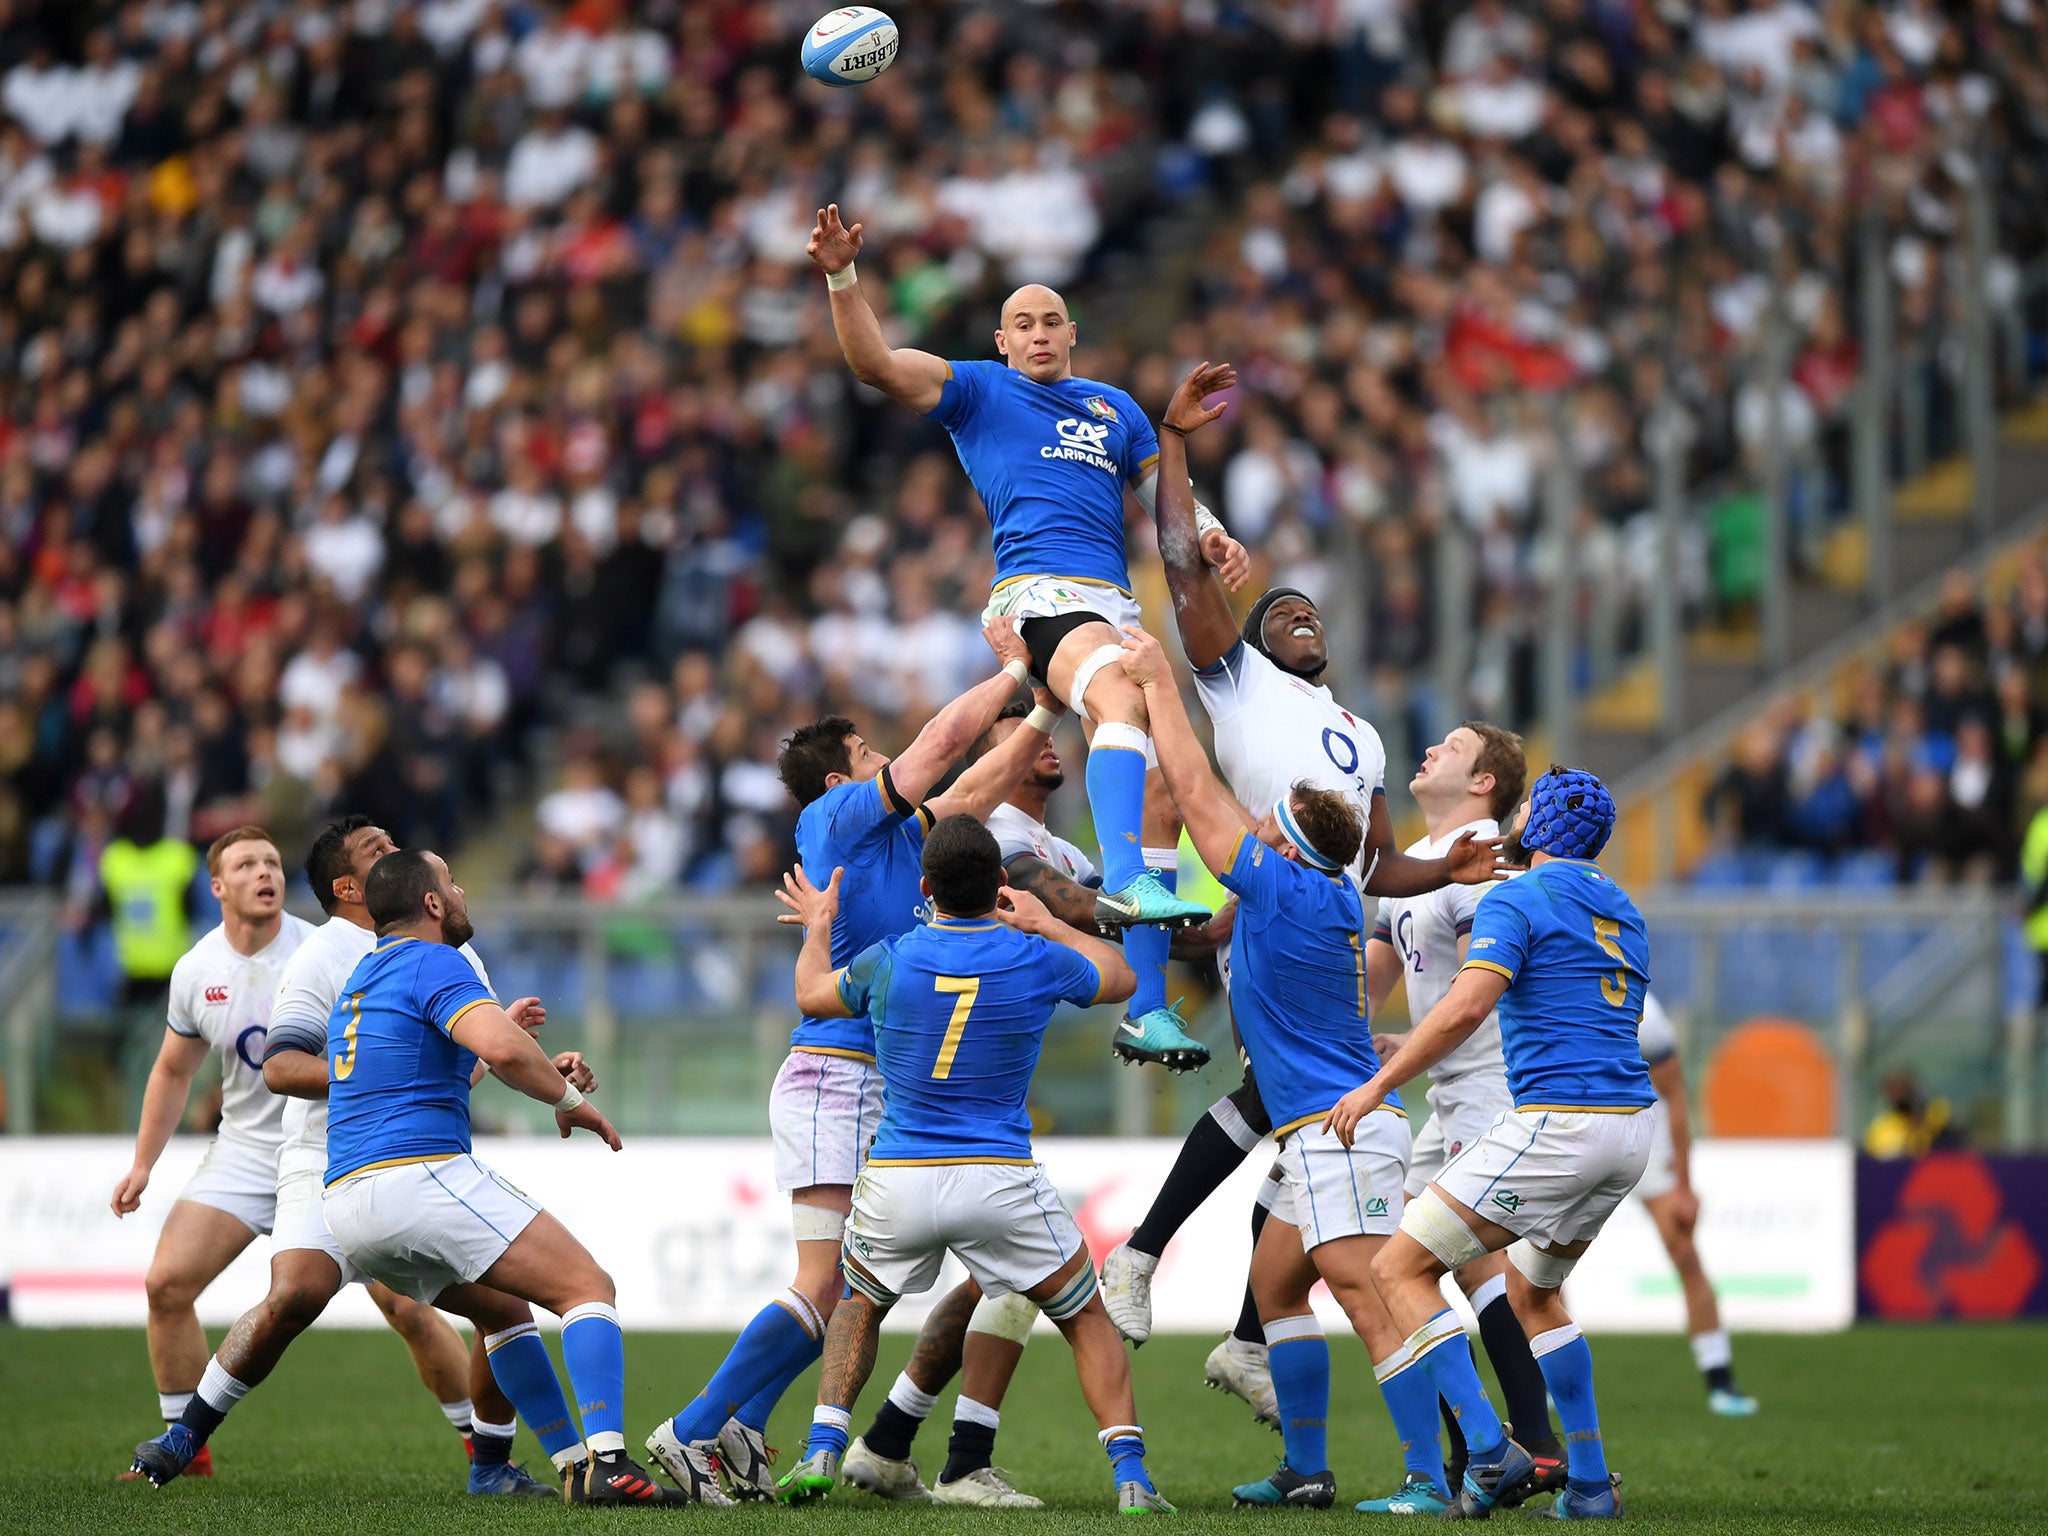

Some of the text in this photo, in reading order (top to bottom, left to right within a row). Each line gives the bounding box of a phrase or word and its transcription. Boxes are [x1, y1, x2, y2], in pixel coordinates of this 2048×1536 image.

[1040, 446, 1118, 476] CARIPARMA
[1348, 930, 1366, 1018] 1
[1397, 910, 1424, 972] O2
[1591, 916, 1632, 1008] 5
[334, 992, 366, 1081] 3
[931, 975, 980, 1080] 7
[656, 1443, 666, 1455] 10
